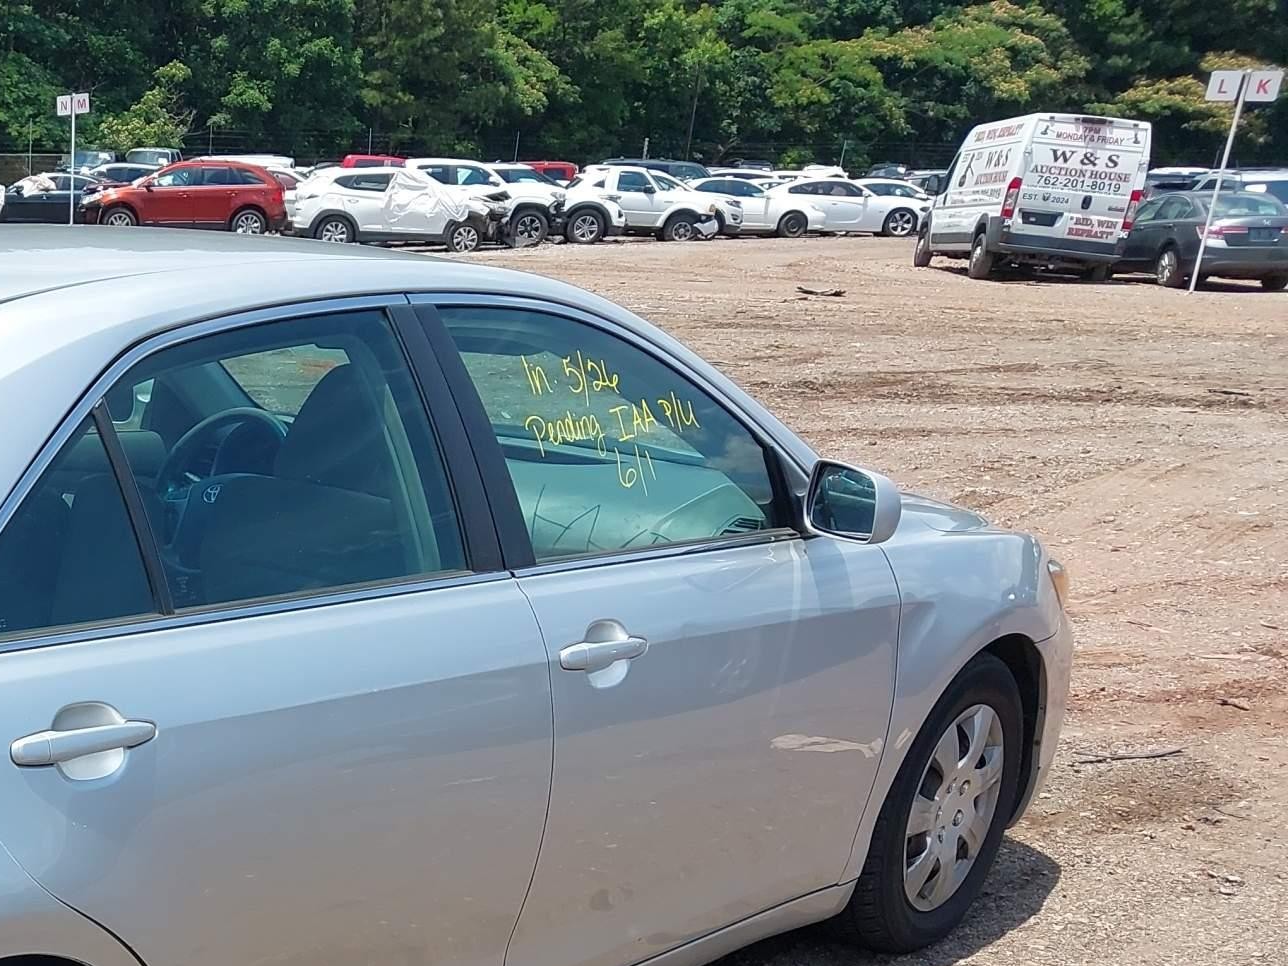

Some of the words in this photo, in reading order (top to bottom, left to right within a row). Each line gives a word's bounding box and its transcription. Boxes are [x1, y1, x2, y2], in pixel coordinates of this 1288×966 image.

[1217, 79, 1228, 94] L
[1256, 79, 1272, 94] K
[60, 100, 68, 111] N
[77, 98, 87, 109] M
[1055, 131, 1088, 143] MONDAY
[1095, 136, 1125, 145] FRIDAY
[1083, 126, 1101, 135] 7PM
[1050, 148, 1077, 164] W
[1080, 152, 1100, 167] &
[1105, 154, 1120, 168] S
[1030, 164, 1088, 179] AUCTION
[1088, 170, 1132, 183] HOUSE
[1036, 174, 1121, 193] 762-201-8019
[1051, 196, 1070, 204] 2024
[1097, 219, 1118, 230] WIN
[562, 350, 620, 407] 5/26
[525, 411, 607, 458] Pending
[609, 398, 658, 442] IAA
[657, 391, 700, 433] P/U
[615, 444, 657, 496] 6/1
